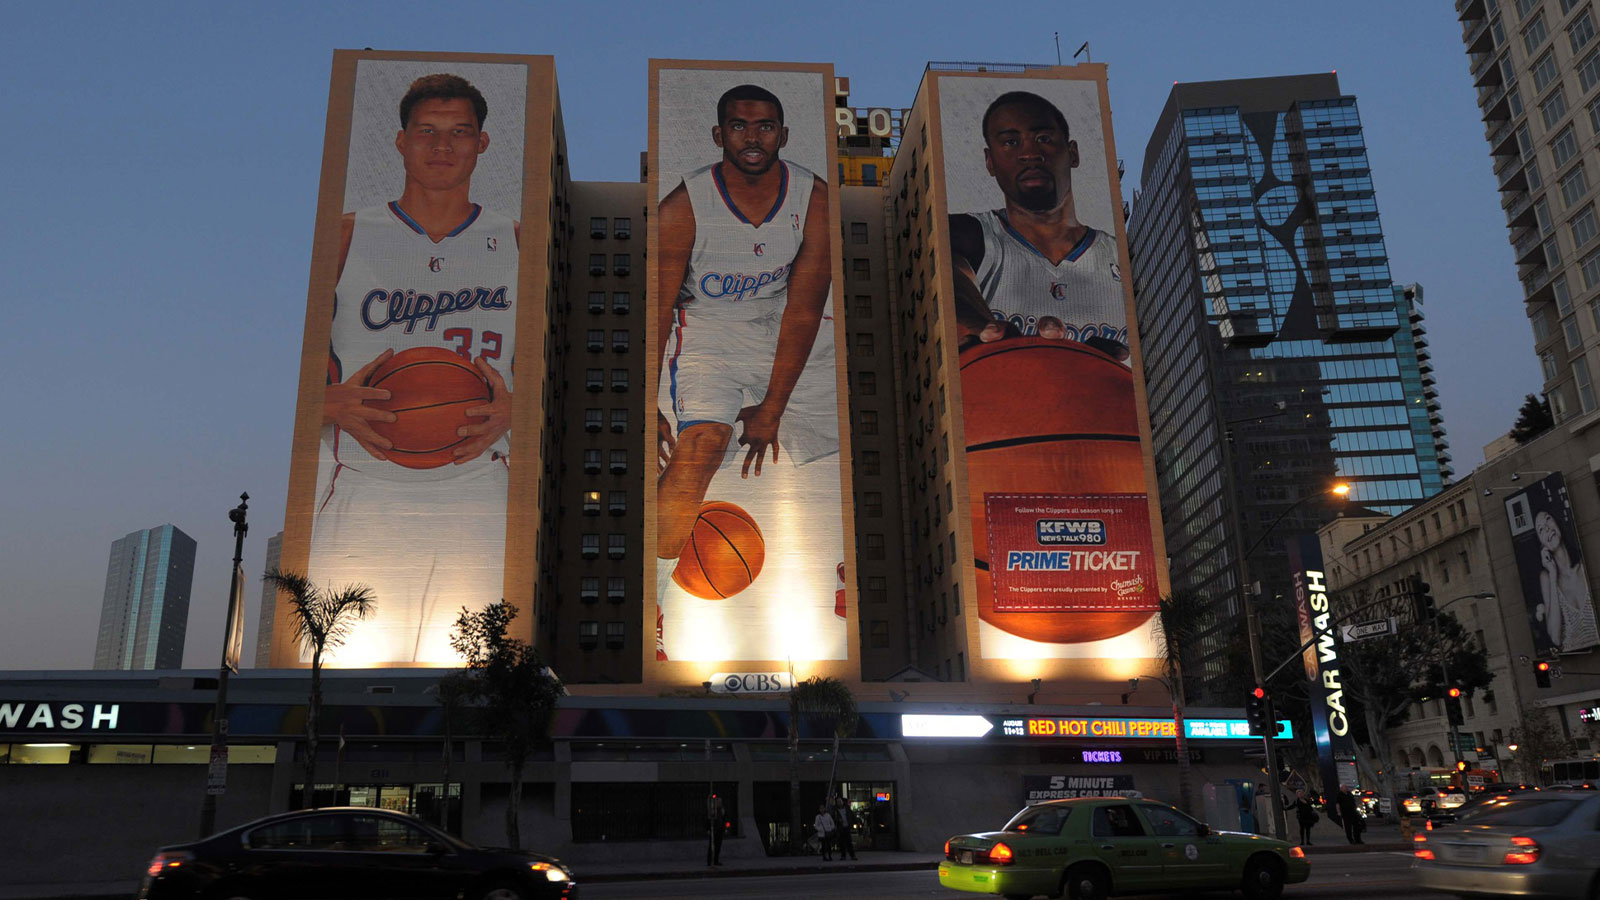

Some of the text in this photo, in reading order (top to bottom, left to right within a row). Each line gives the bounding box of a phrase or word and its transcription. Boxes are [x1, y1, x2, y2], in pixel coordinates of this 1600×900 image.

[836, 107, 912, 136] RO
[360, 286, 512, 335] Clippers
[443, 327, 502, 361] 32
[1045, 507, 1070, 515] Clippers
[1039, 521, 1102, 533] KFWB
[1079, 534, 1101, 543] 980
[1006, 550, 1140, 571] PRIME TICKET
[1305, 570, 1337, 664] WASH
[1356, 623, 1386, 635] ONE WAY
[742, 674, 782, 691] CBS
[1322, 669, 1348, 737] CAR
[0, 703, 121, 730] WASH
[1028, 720, 1056, 736] RED
[1059, 720, 1088, 736] HOT
[1091, 720, 1127, 736] CHILI
[1082, 751, 1122, 762] TICKETS
[1144, 751, 1201, 761] VIP TICTS
[1049, 776, 1114, 789] 5 MINUTE
[1029, 790, 1077, 800] EXPRESS
[1079, 790, 1100, 798] CAR
